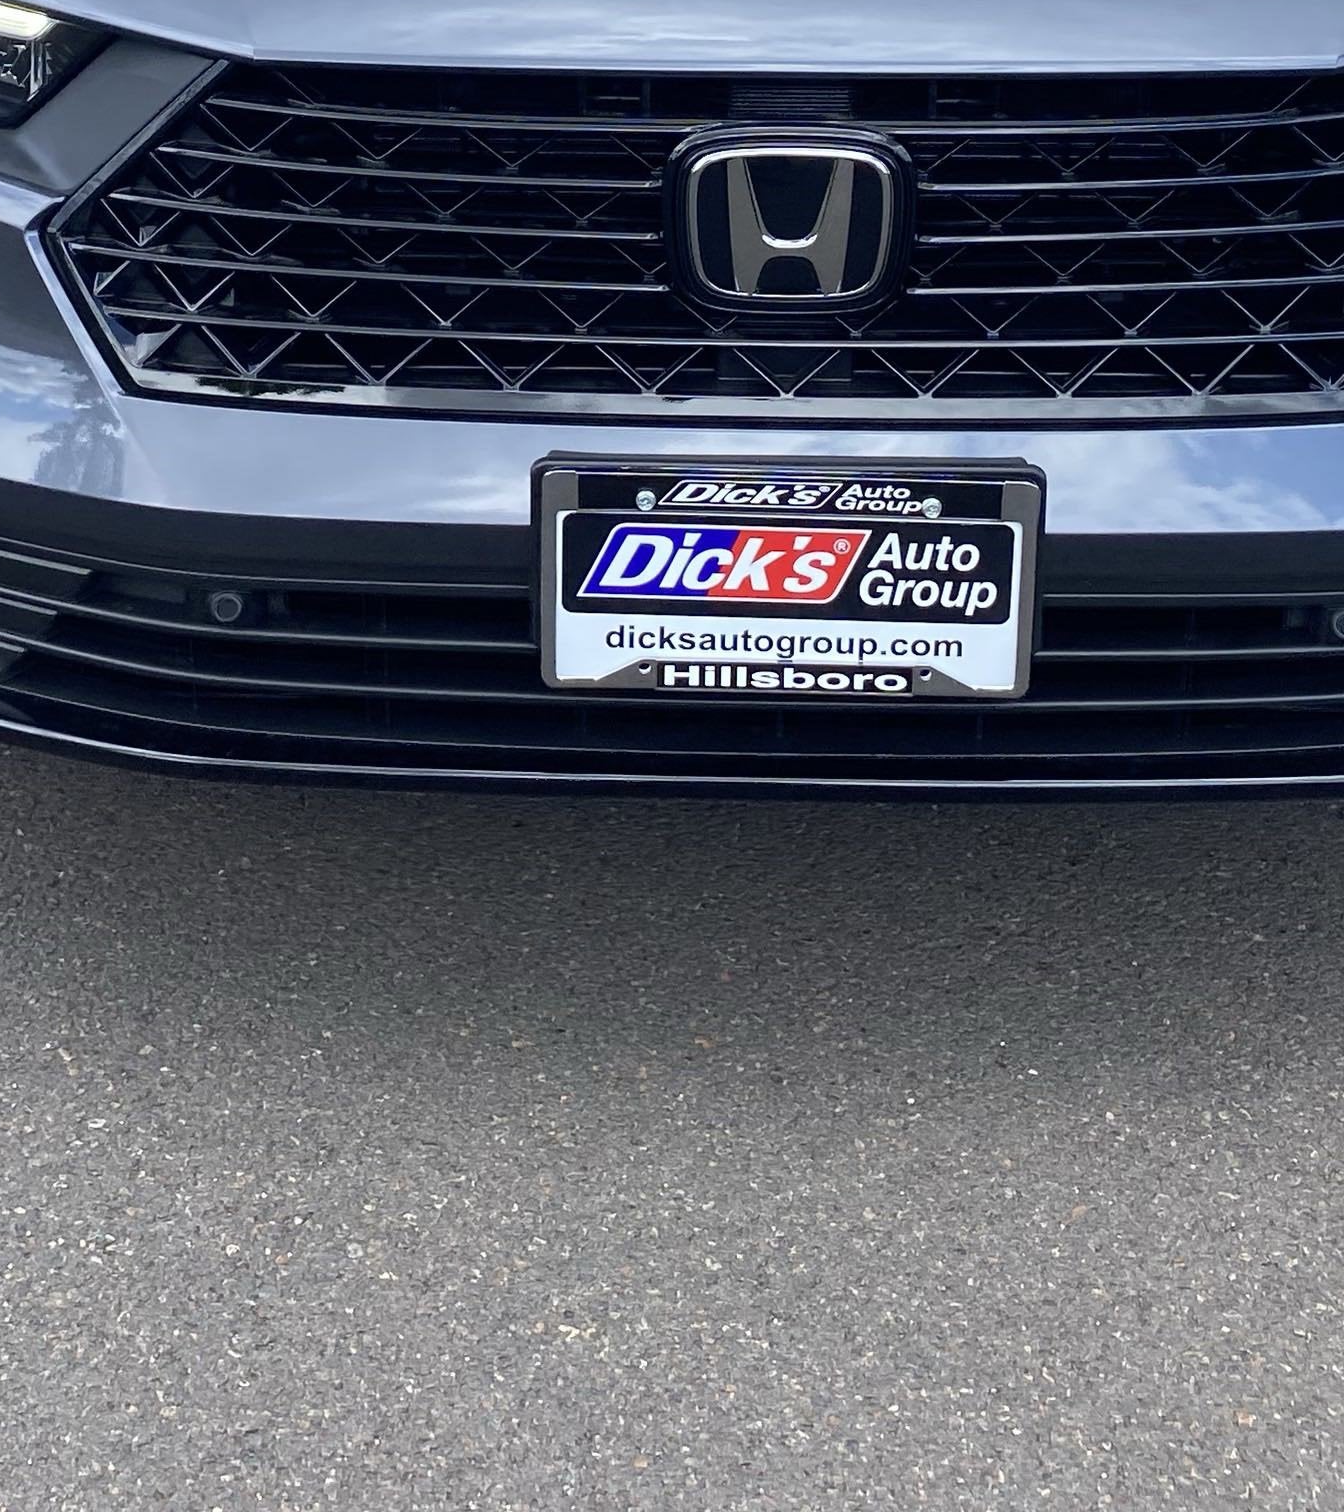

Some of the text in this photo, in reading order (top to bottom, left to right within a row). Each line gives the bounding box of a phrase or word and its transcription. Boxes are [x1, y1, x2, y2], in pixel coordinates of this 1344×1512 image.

[834, 497, 923, 515] Group
[841, 483, 912, 500] Auto
[867, 533, 980, 571] Auto
[858, 568, 998, 616] Group
[605, 625, 963, 659] dicksautogroup.com
[662, 664, 908, 692] Hillsboro
